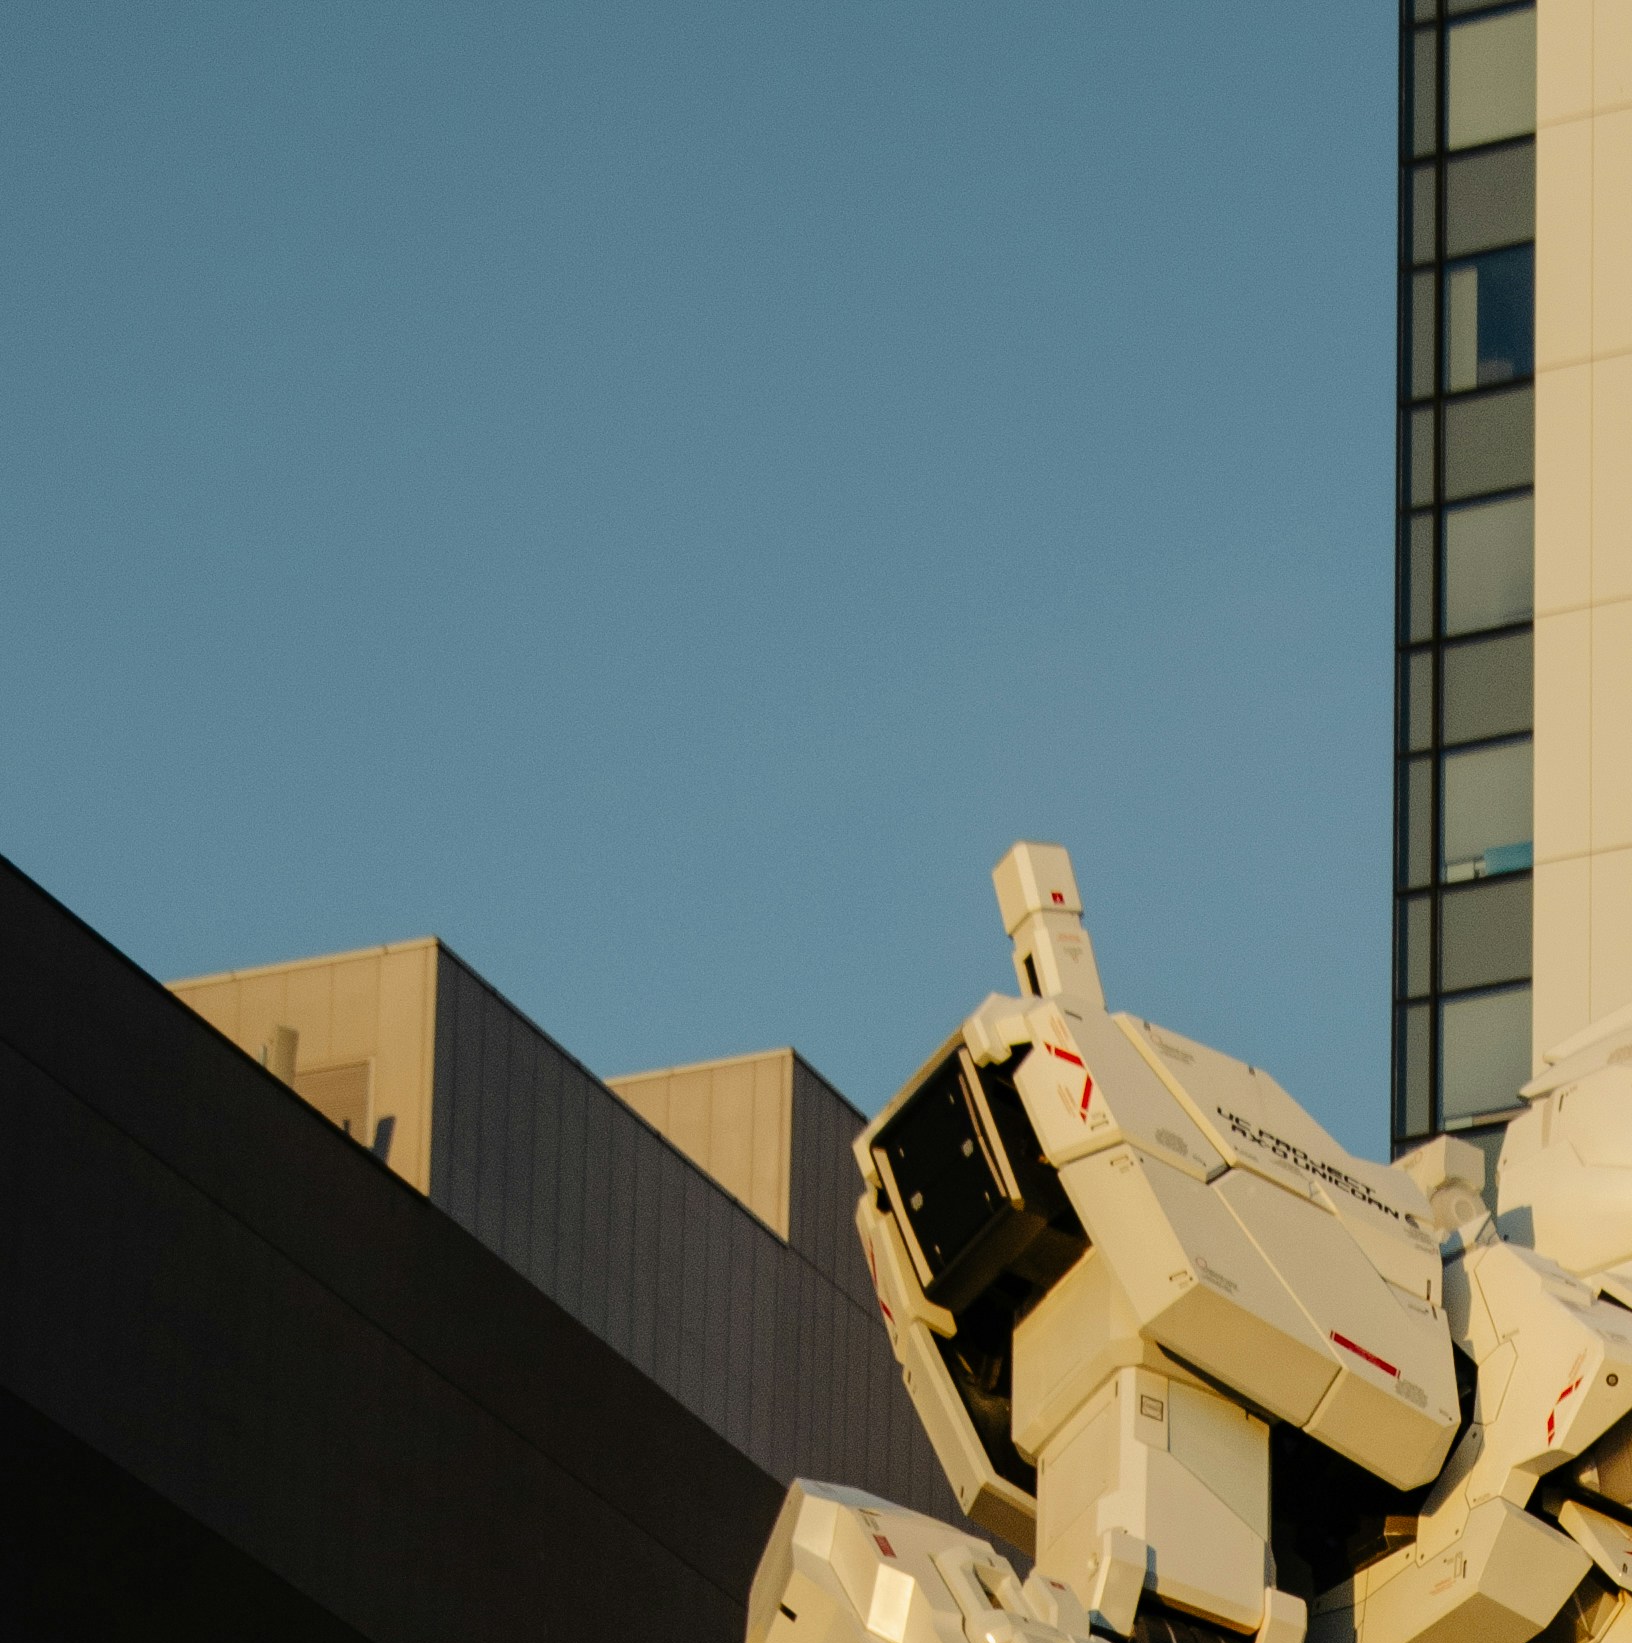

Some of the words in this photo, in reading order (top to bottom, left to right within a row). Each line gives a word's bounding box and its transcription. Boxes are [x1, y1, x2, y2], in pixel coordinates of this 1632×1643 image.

[1217, 1106, 1251, 1127] UC
[1258, 1128, 1376, 1195] PROJECT
[1293, 1156, 1399, 1220] UNICORN
